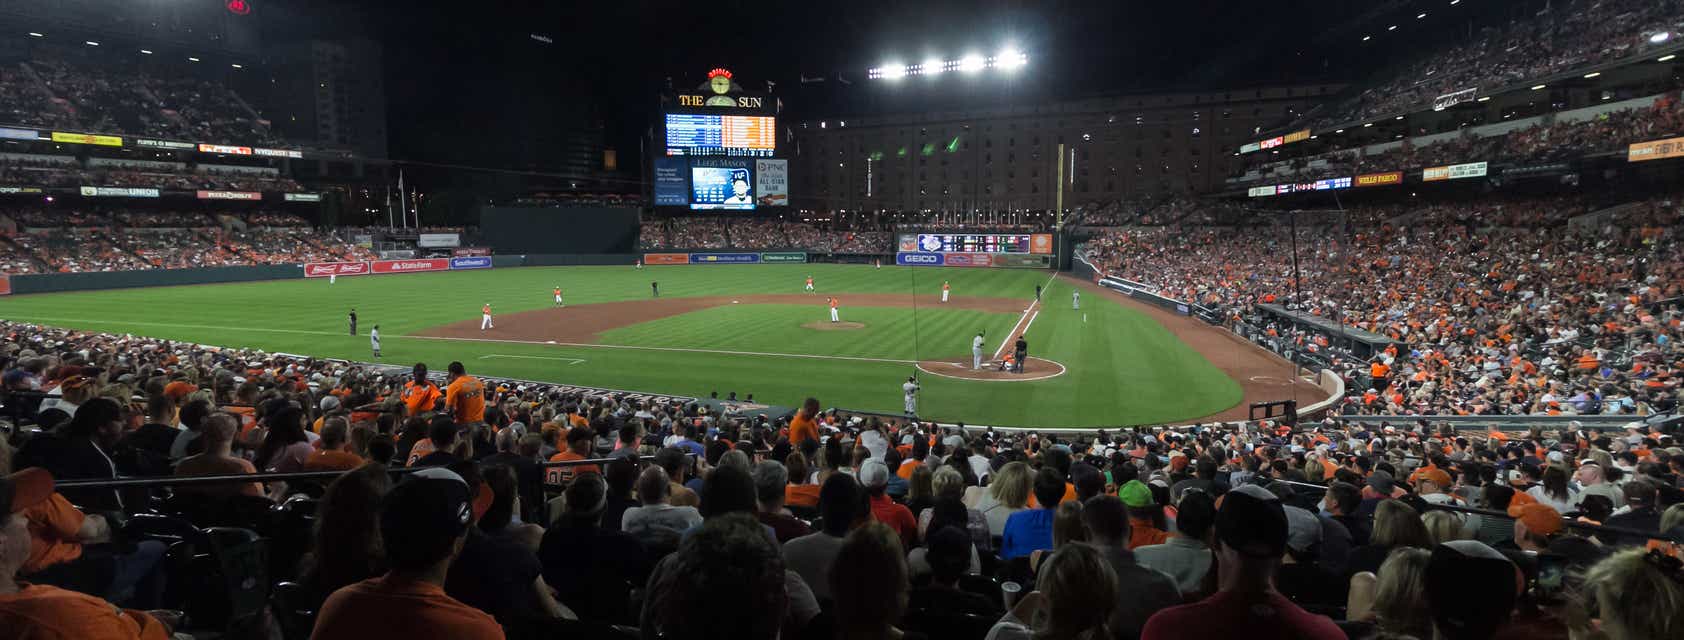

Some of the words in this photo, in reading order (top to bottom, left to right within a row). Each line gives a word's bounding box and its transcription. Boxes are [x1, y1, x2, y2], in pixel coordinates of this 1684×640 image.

[679, 95, 704, 106] THE
[738, 96, 761, 107] SUN
[128, 187, 159, 197] UNION
[904, 254, 937, 263] GEICO
